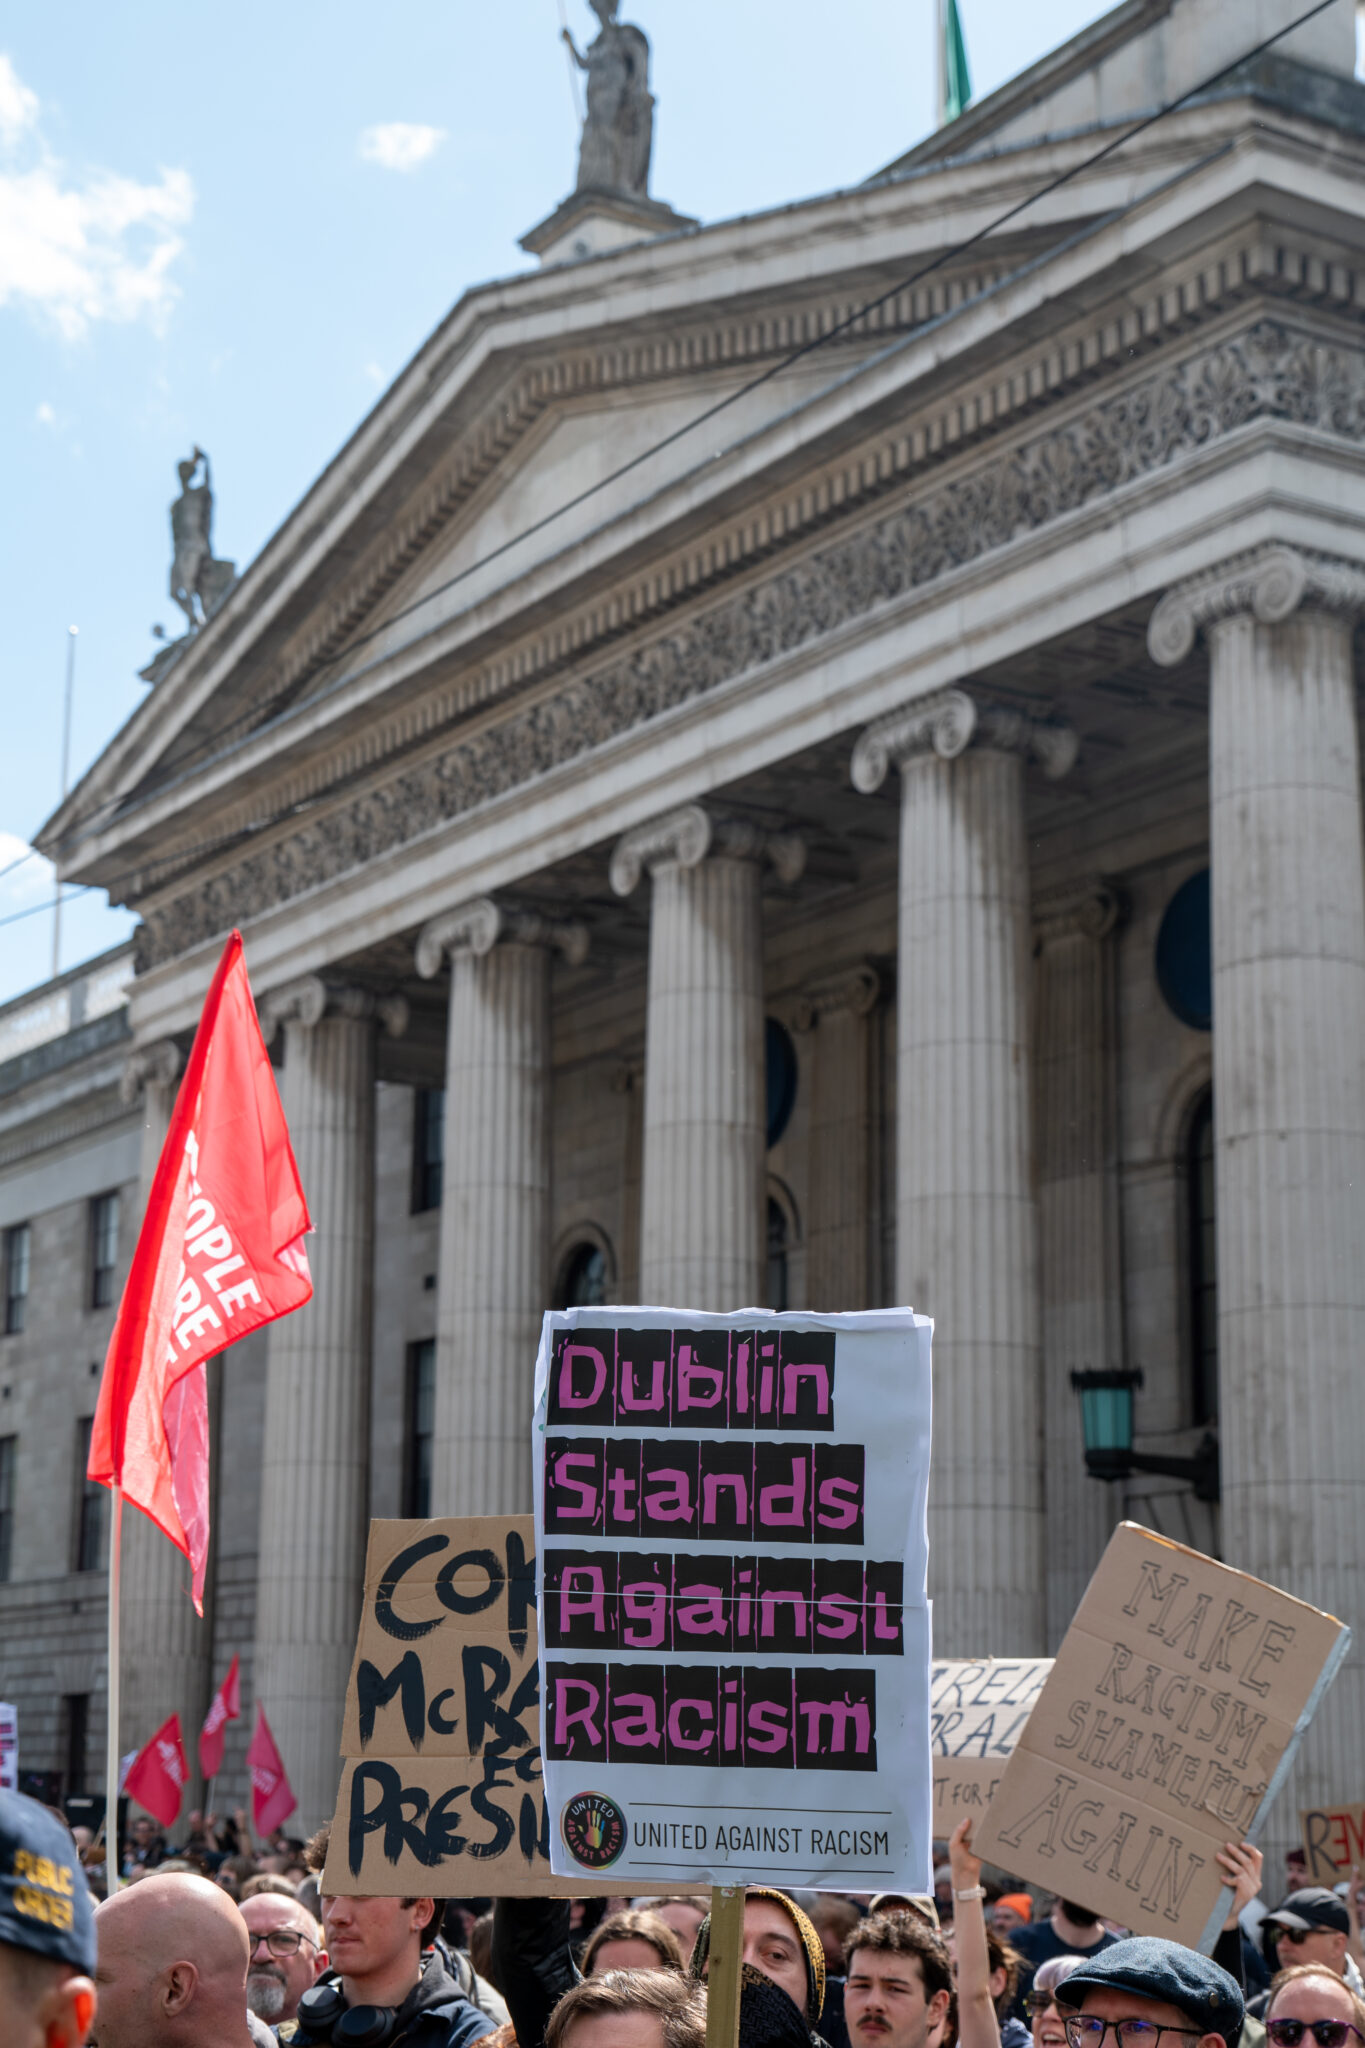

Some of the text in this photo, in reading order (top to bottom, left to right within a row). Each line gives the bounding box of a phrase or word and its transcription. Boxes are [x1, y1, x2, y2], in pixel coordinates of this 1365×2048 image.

[558, 1342, 829, 1415] Dublin
[555, 1452, 860, 1530] Stands
[559, 1566, 900, 1648] Against
[1122, 1560, 1296, 1698] MAKE
[554, 1677, 871, 1755] Racism
[1095, 1641, 1268, 1770] RACISM
[567, 1818, 594, 1860] AGAINST
[571, 1799, 615, 1818] UNITED
[600, 1821, 620, 1859] RACISM
[633, 1822, 890, 1856] UNITED AGAINST RACISM
[997, 1773, 1206, 1923] AGAIN
